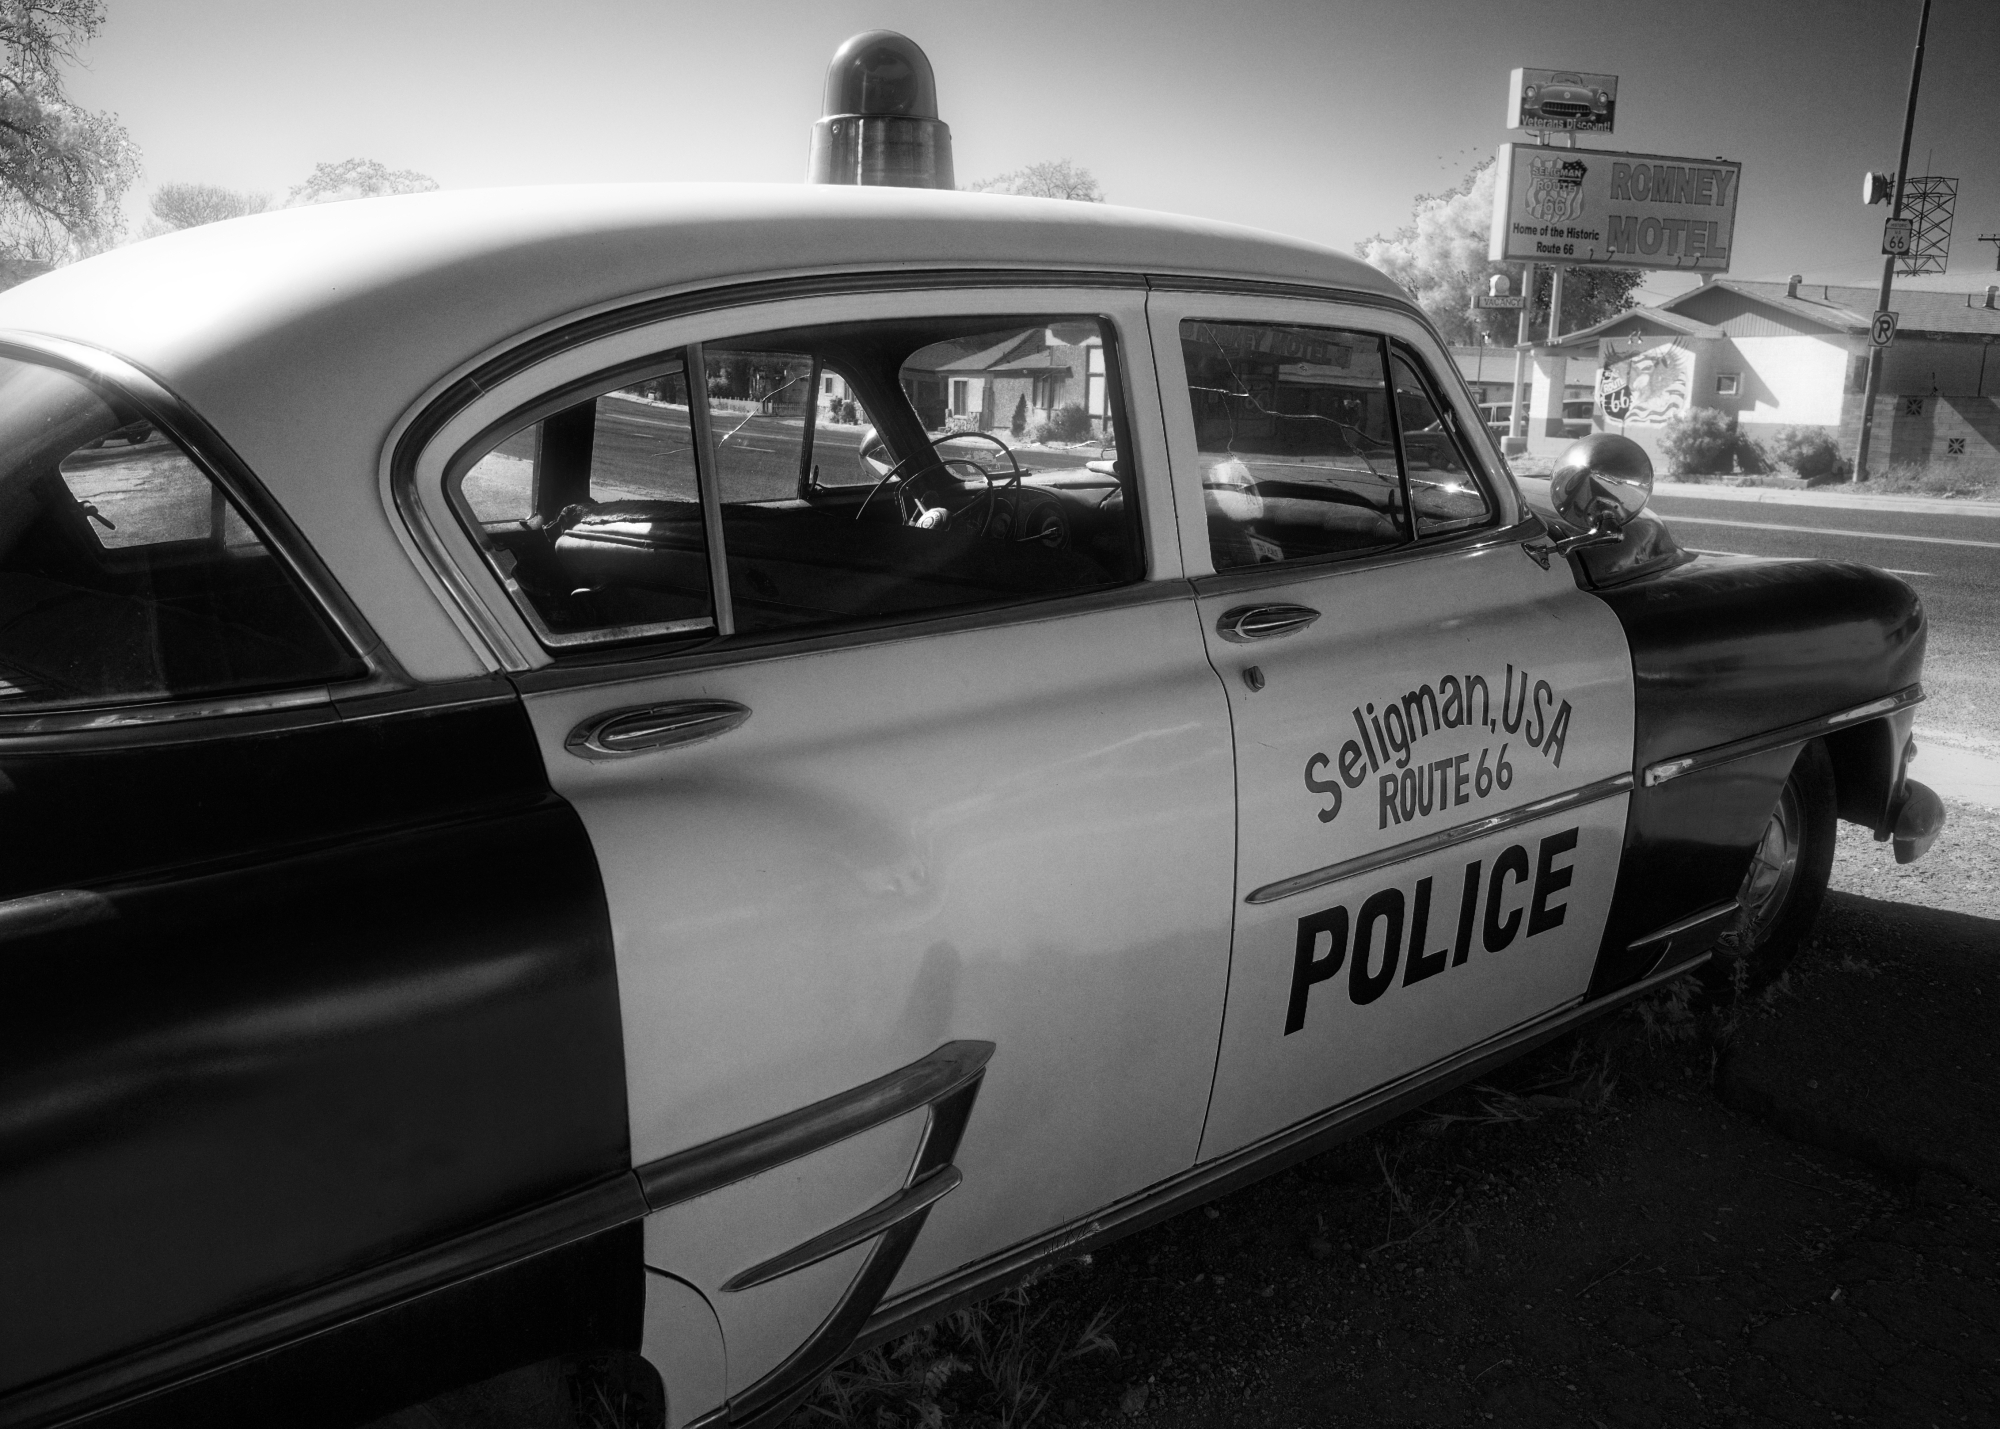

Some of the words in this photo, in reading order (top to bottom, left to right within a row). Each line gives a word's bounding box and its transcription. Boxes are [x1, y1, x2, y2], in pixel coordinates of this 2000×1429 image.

[1521, 114, 1564, 129] Veterans
[1566, 118, 1611, 132] Discount!
[1532, 166, 1582, 178] SELIGMAN
[1537, 181, 1576, 193] ROUTE
[1610, 162, 1735, 206] ROMNEY
[1543, 196, 1566, 215] 66
[1513, 222, 1538, 235] Home
[1540, 225, 1550, 236] of
[1550, 226, 1565, 237] the
[1566, 227, 1600, 241] Historic
[1606, 214, 1727, 259] MOTEL
[1536, 241, 1561, 254] Route
[1563, 244, 1575, 255] 66
[1889, 236, 1904, 249] 66
[1484, 297, 1521, 307] VACANCY
[1610, 389, 1630, 413] 66
[1378, 752, 1470, 830] ROUTE
[1474, 743, 1513, 798] 66
[1283, 826, 1580, 1037] POLICE
